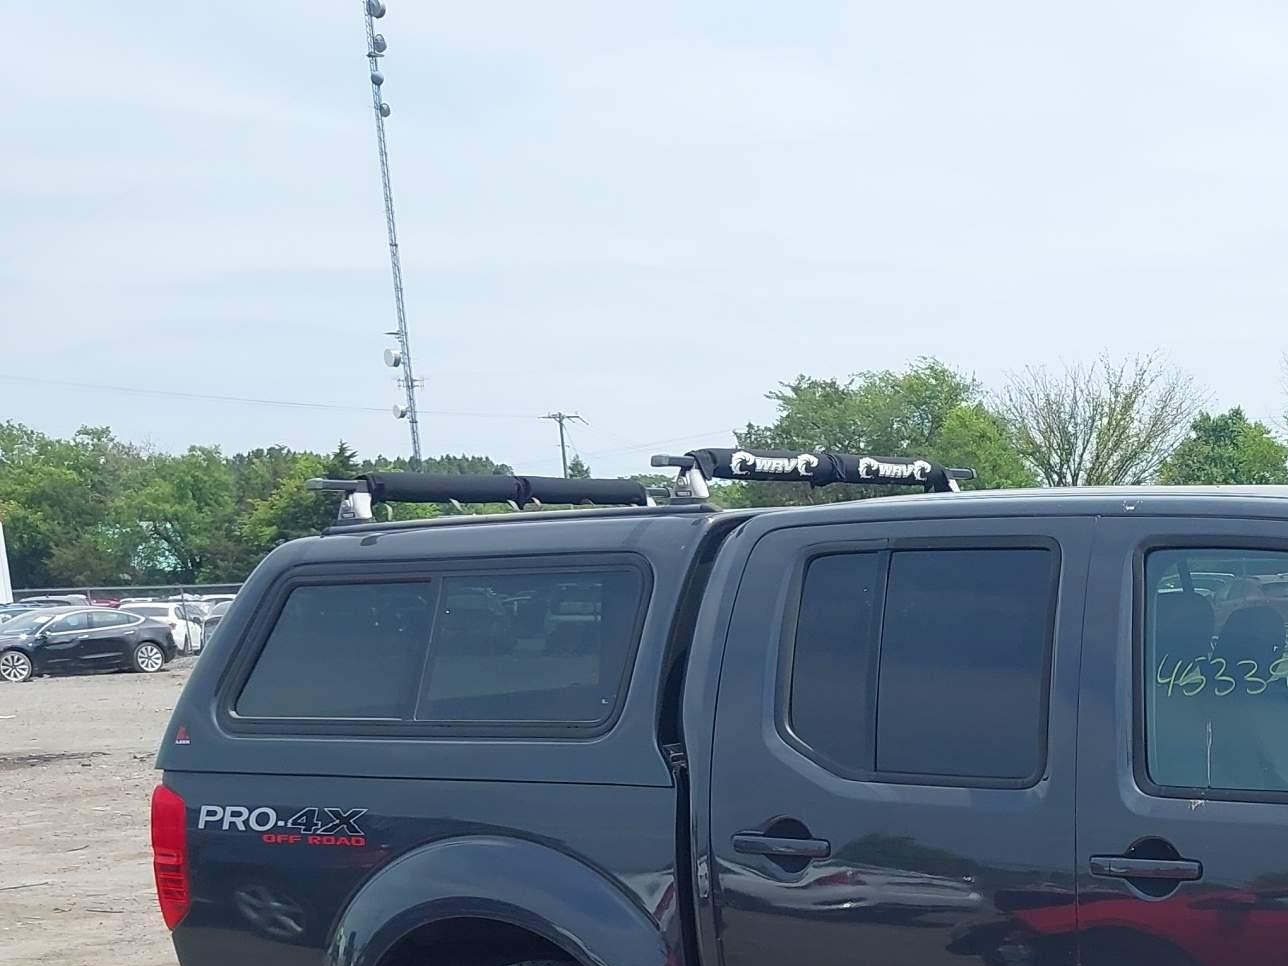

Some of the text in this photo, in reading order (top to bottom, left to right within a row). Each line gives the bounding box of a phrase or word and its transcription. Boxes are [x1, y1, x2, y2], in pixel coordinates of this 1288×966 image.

[755, 457, 798, 474] WRV
[878, 462, 915, 478] WRV
[262, 833, 366, 847] OFF ROAD
